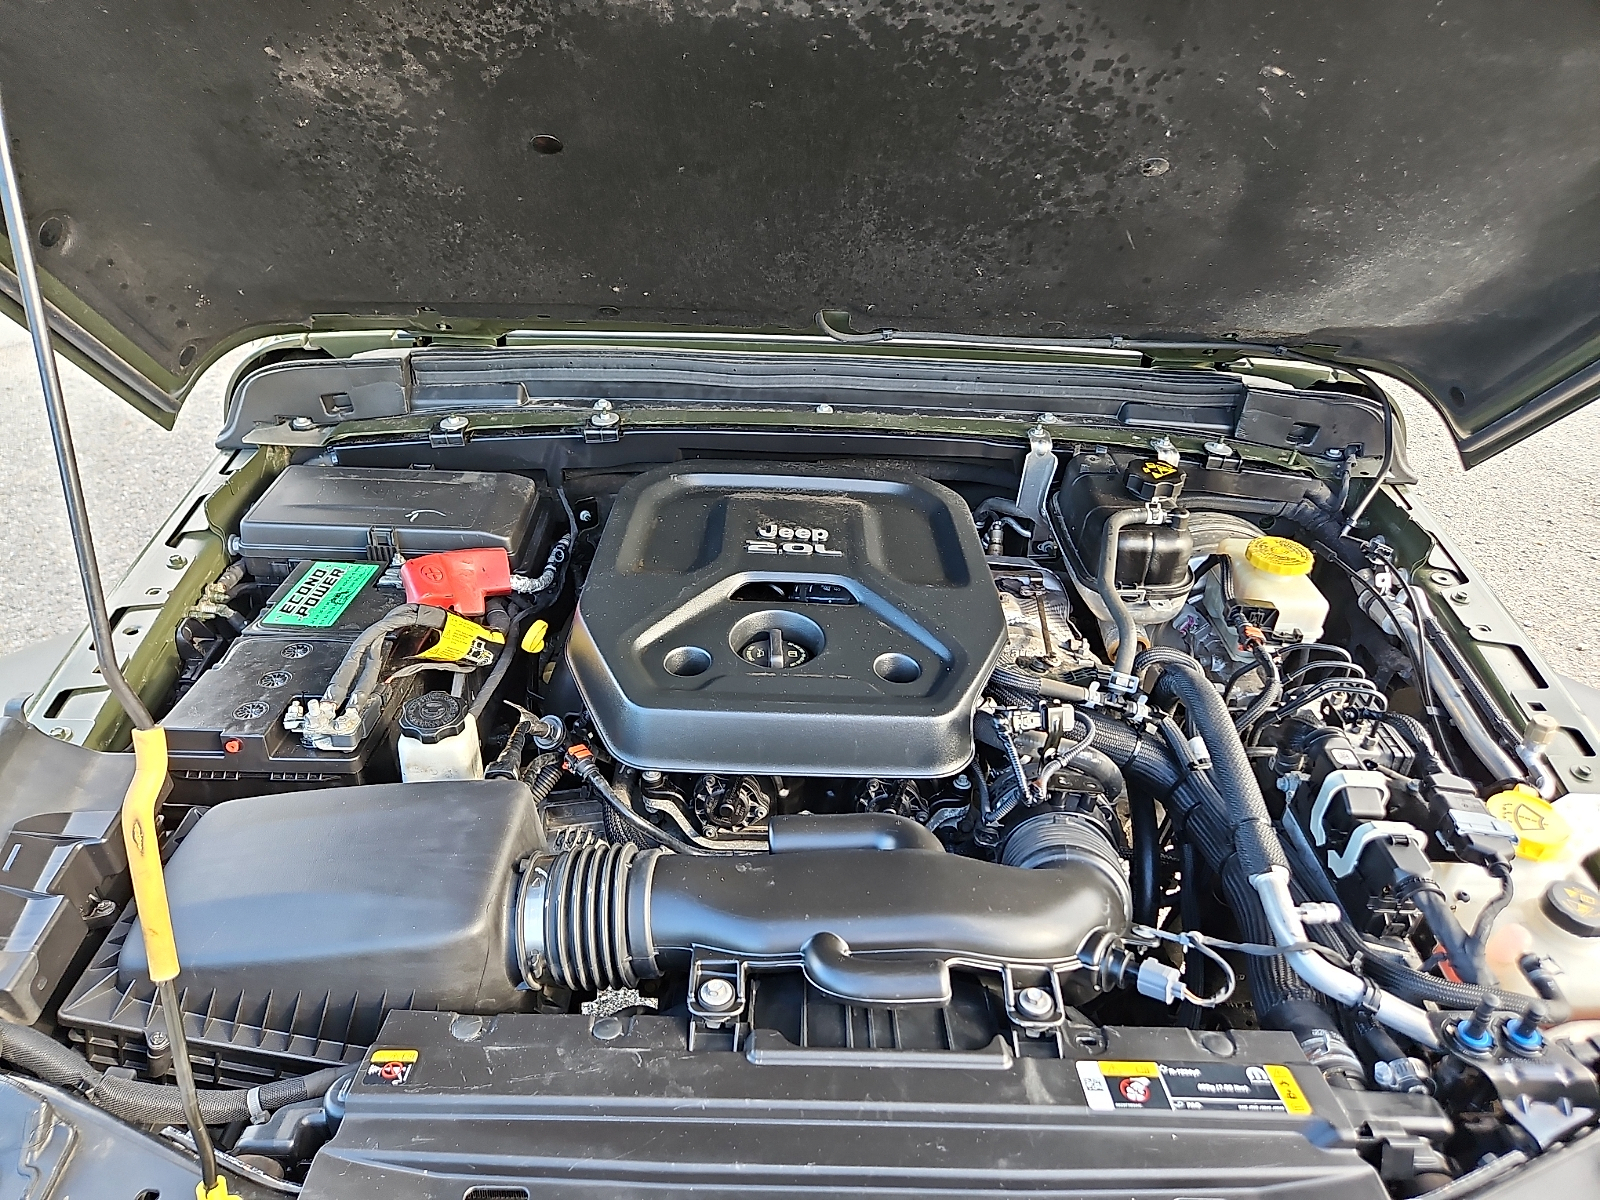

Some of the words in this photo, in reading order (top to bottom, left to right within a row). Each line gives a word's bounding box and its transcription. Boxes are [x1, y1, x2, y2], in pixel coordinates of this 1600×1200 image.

[744, 540, 844, 557] 2.0L
[756, 523, 829, 542] Jeep
[280, 568, 327, 614] ECONO
[296, 567, 345, 617] POWER
